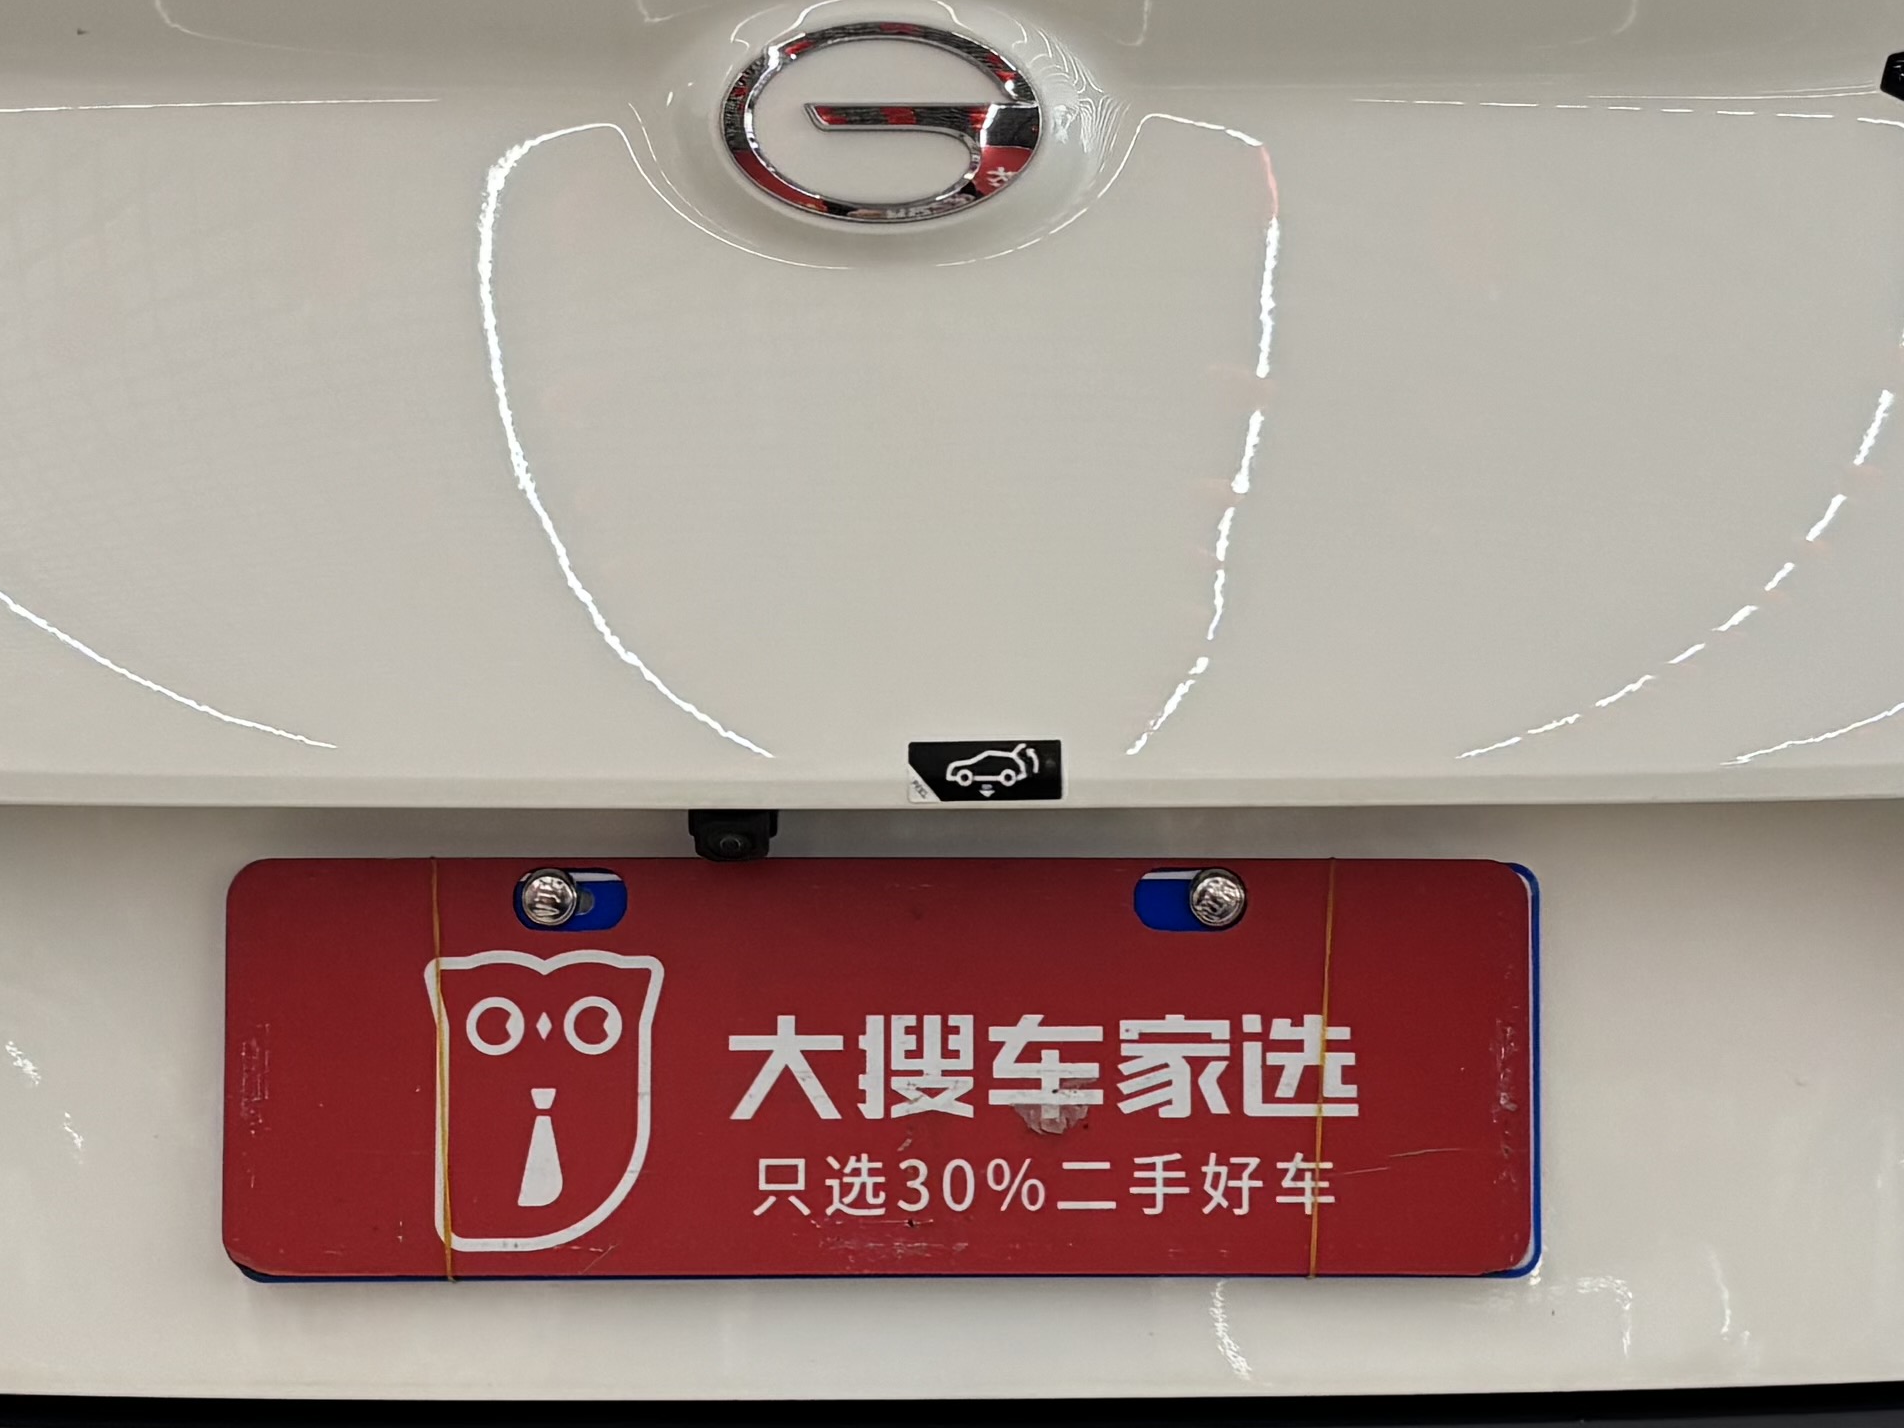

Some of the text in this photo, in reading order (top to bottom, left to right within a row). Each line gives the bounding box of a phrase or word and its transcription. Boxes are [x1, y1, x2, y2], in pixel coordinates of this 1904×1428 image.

[728, 1013, 1360, 1121] 大搜车家选
[752, 1153, 1338, 1217] 只选30%二手好车
